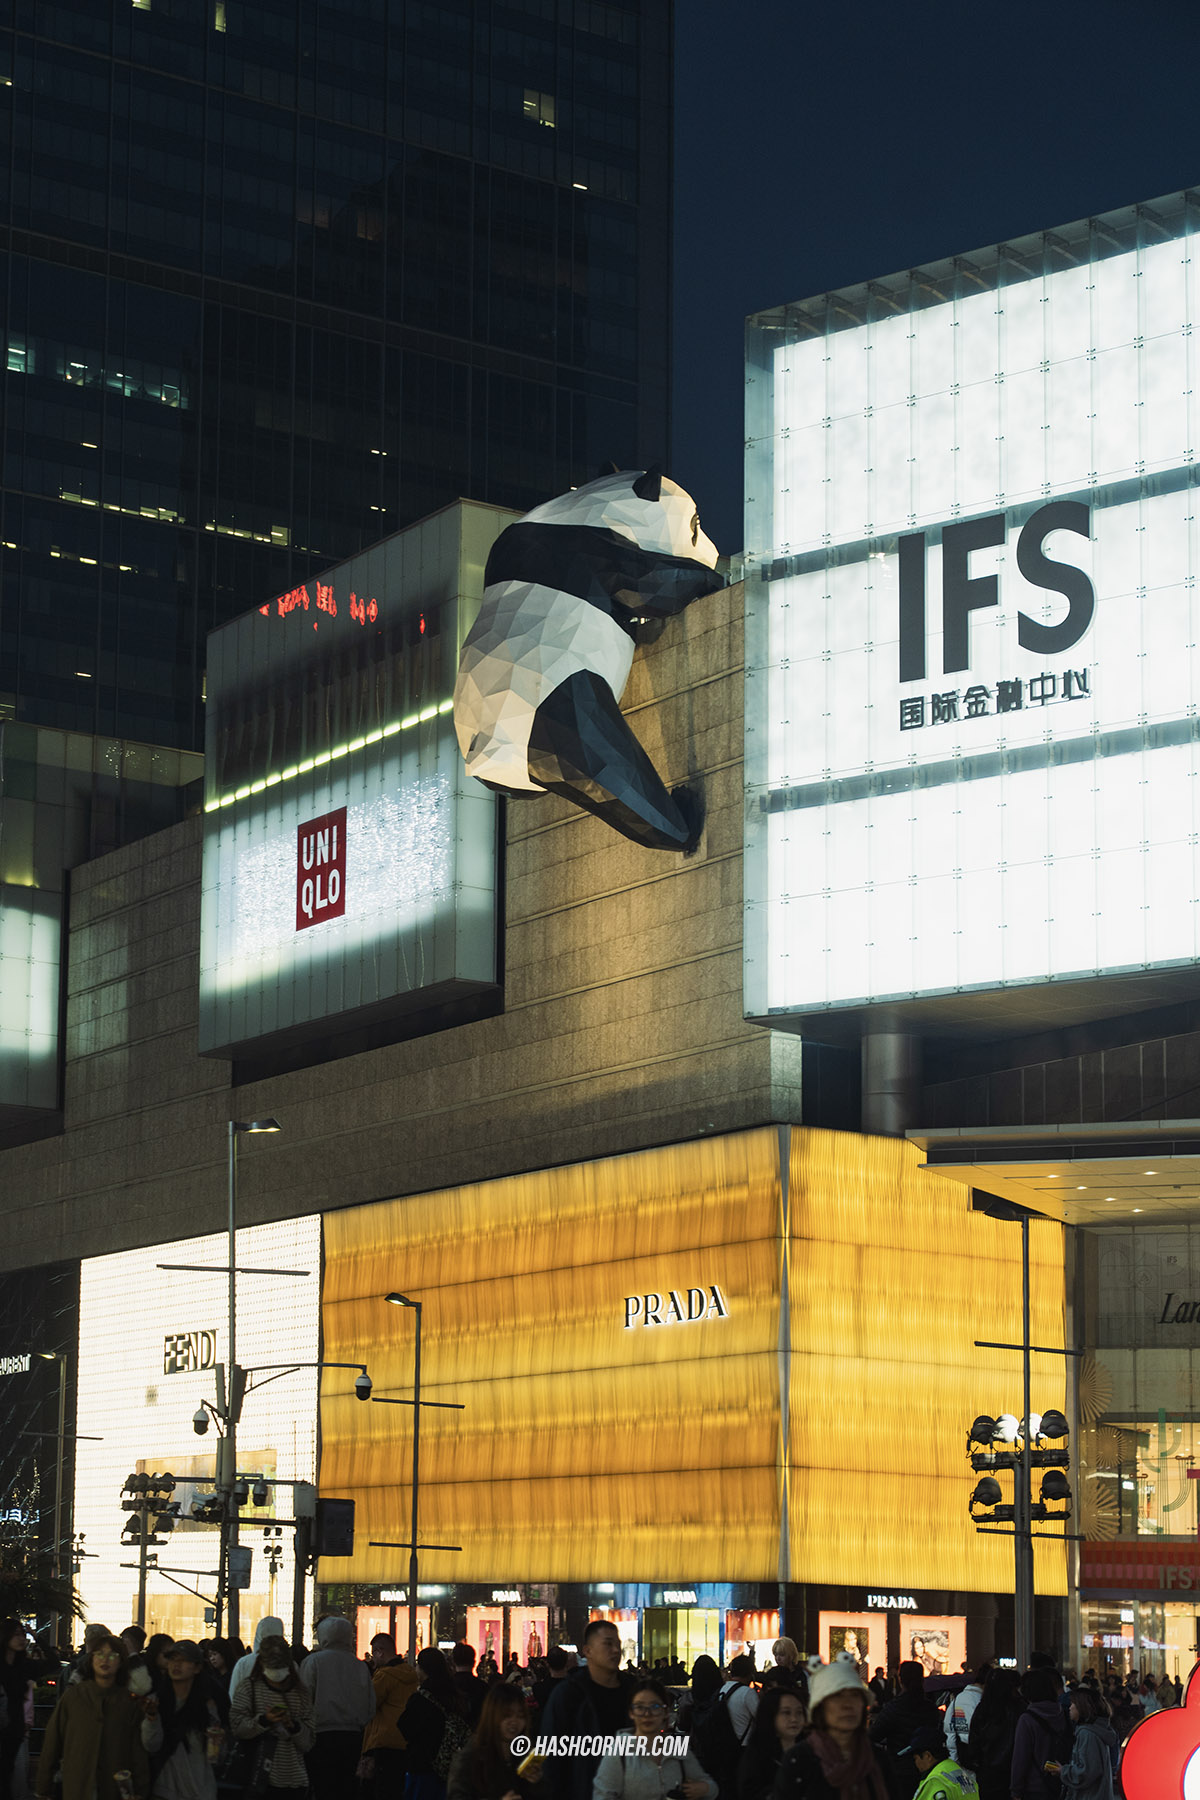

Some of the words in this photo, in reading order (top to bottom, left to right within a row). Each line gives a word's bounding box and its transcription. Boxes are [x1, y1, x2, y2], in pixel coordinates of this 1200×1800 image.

[899, 501, 1095, 683] IFS
[900, 668, 1091, 731] 国际金融中心
[303, 825, 337, 871] UNI
[302, 869, 340, 919] QLO
[624, 1285, 728, 1328] PRADA
[164, 1329, 218, 1375] FENDI
[1160, 1567, 1192, 1589] IFS
[867, 1594, 918, 1609] PRADA
